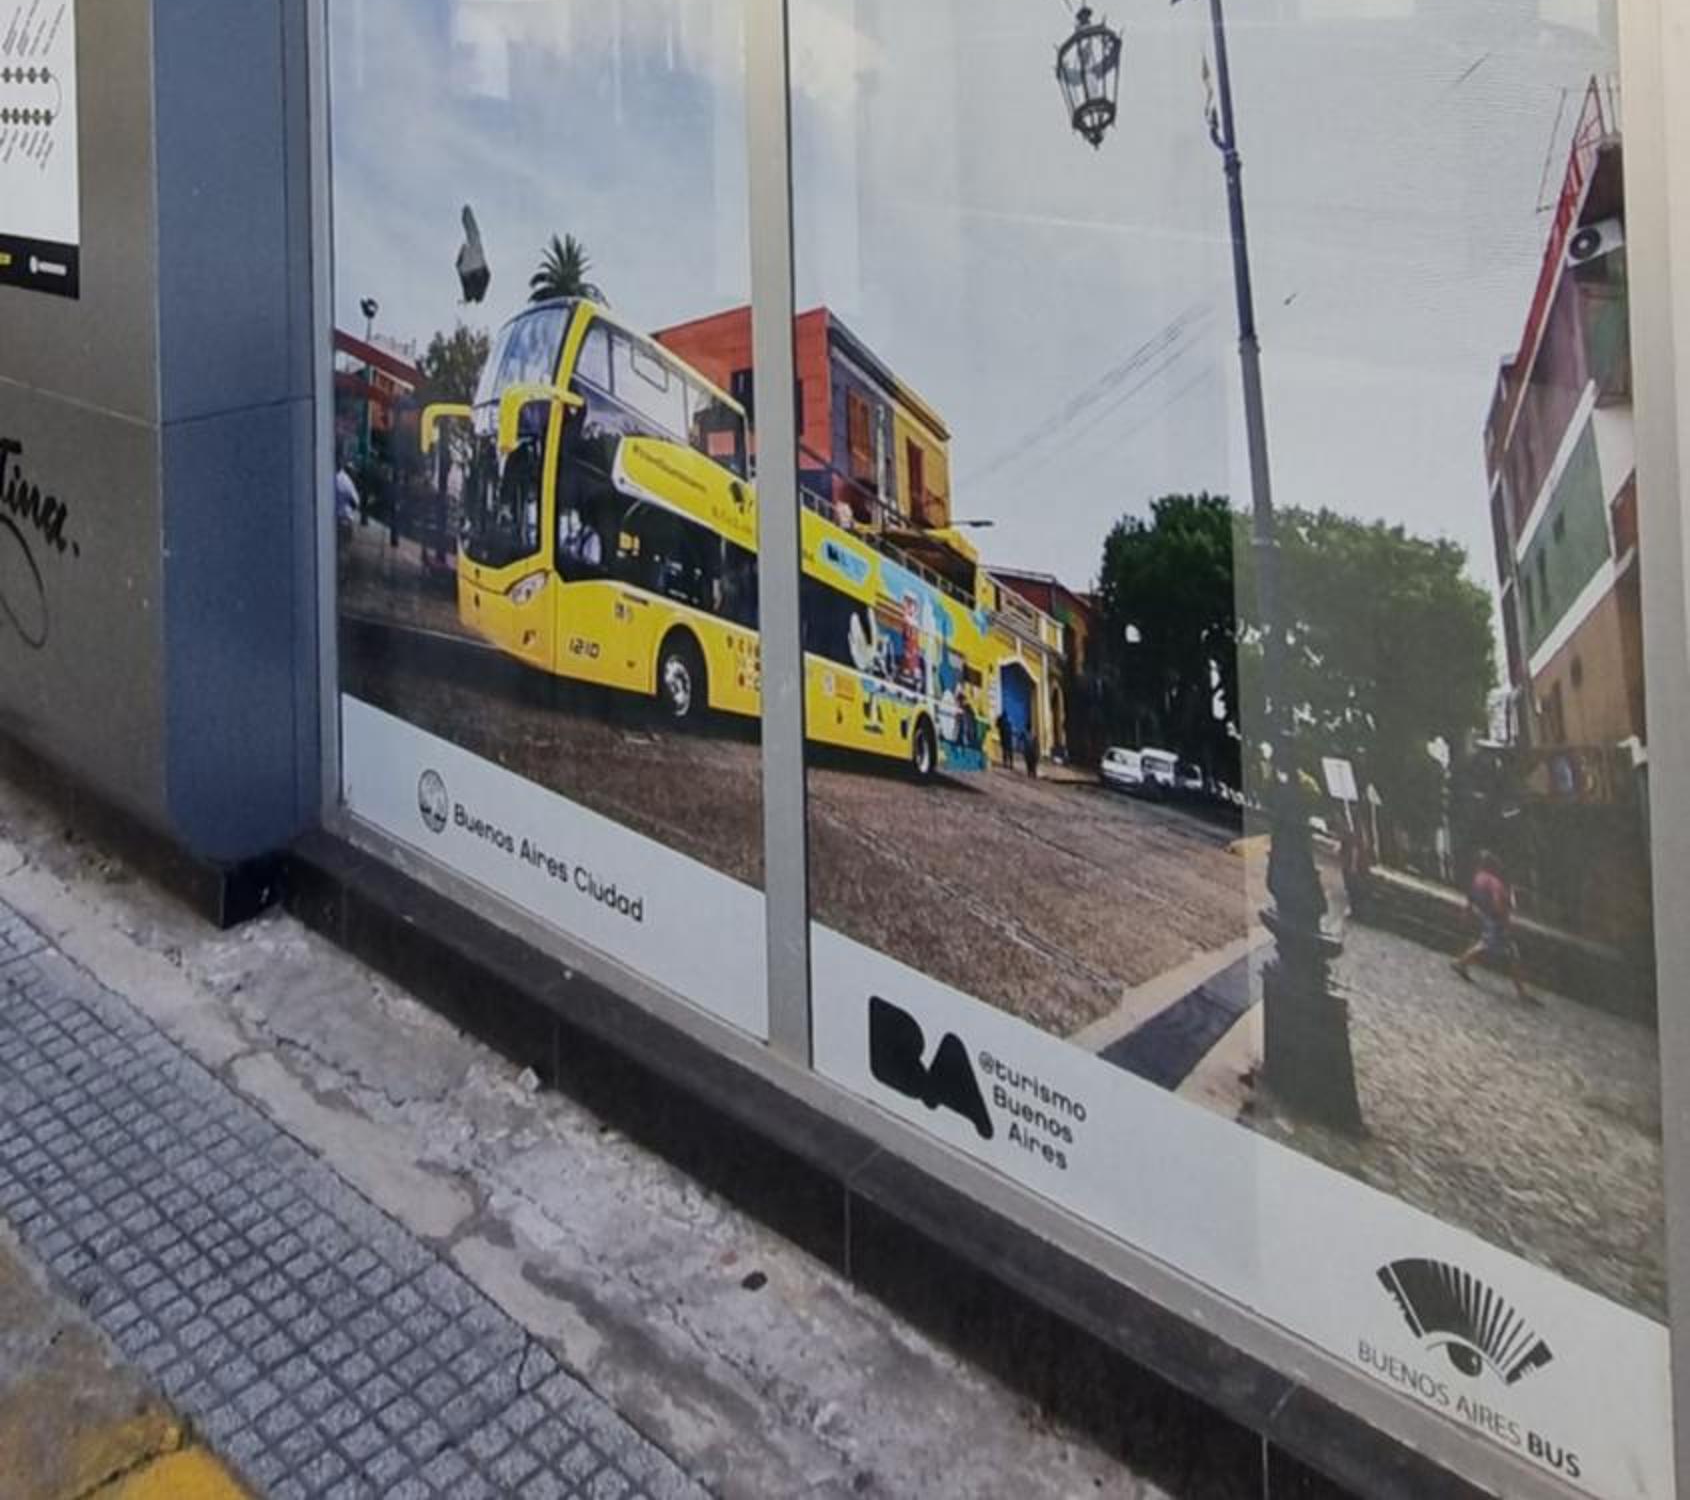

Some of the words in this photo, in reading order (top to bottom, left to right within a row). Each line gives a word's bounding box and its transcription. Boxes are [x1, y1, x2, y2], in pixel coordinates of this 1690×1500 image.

[453, 802, 515, 854] Buenos
[519, 837, 569, 883] Aires
[573, 865, 644, 923] Ciudad
[978, 1050, 1088, 1123] @turismo
[992, 1083, 1074, 1145] Buenos
[1008, 1121, 1068, 1171] Aires
[1357, 1338, 1450, 1406] BUENOS
[1455, 1394, 1522, 1446] AIRES
[1526, 1430, 1582, 1479] BUS
